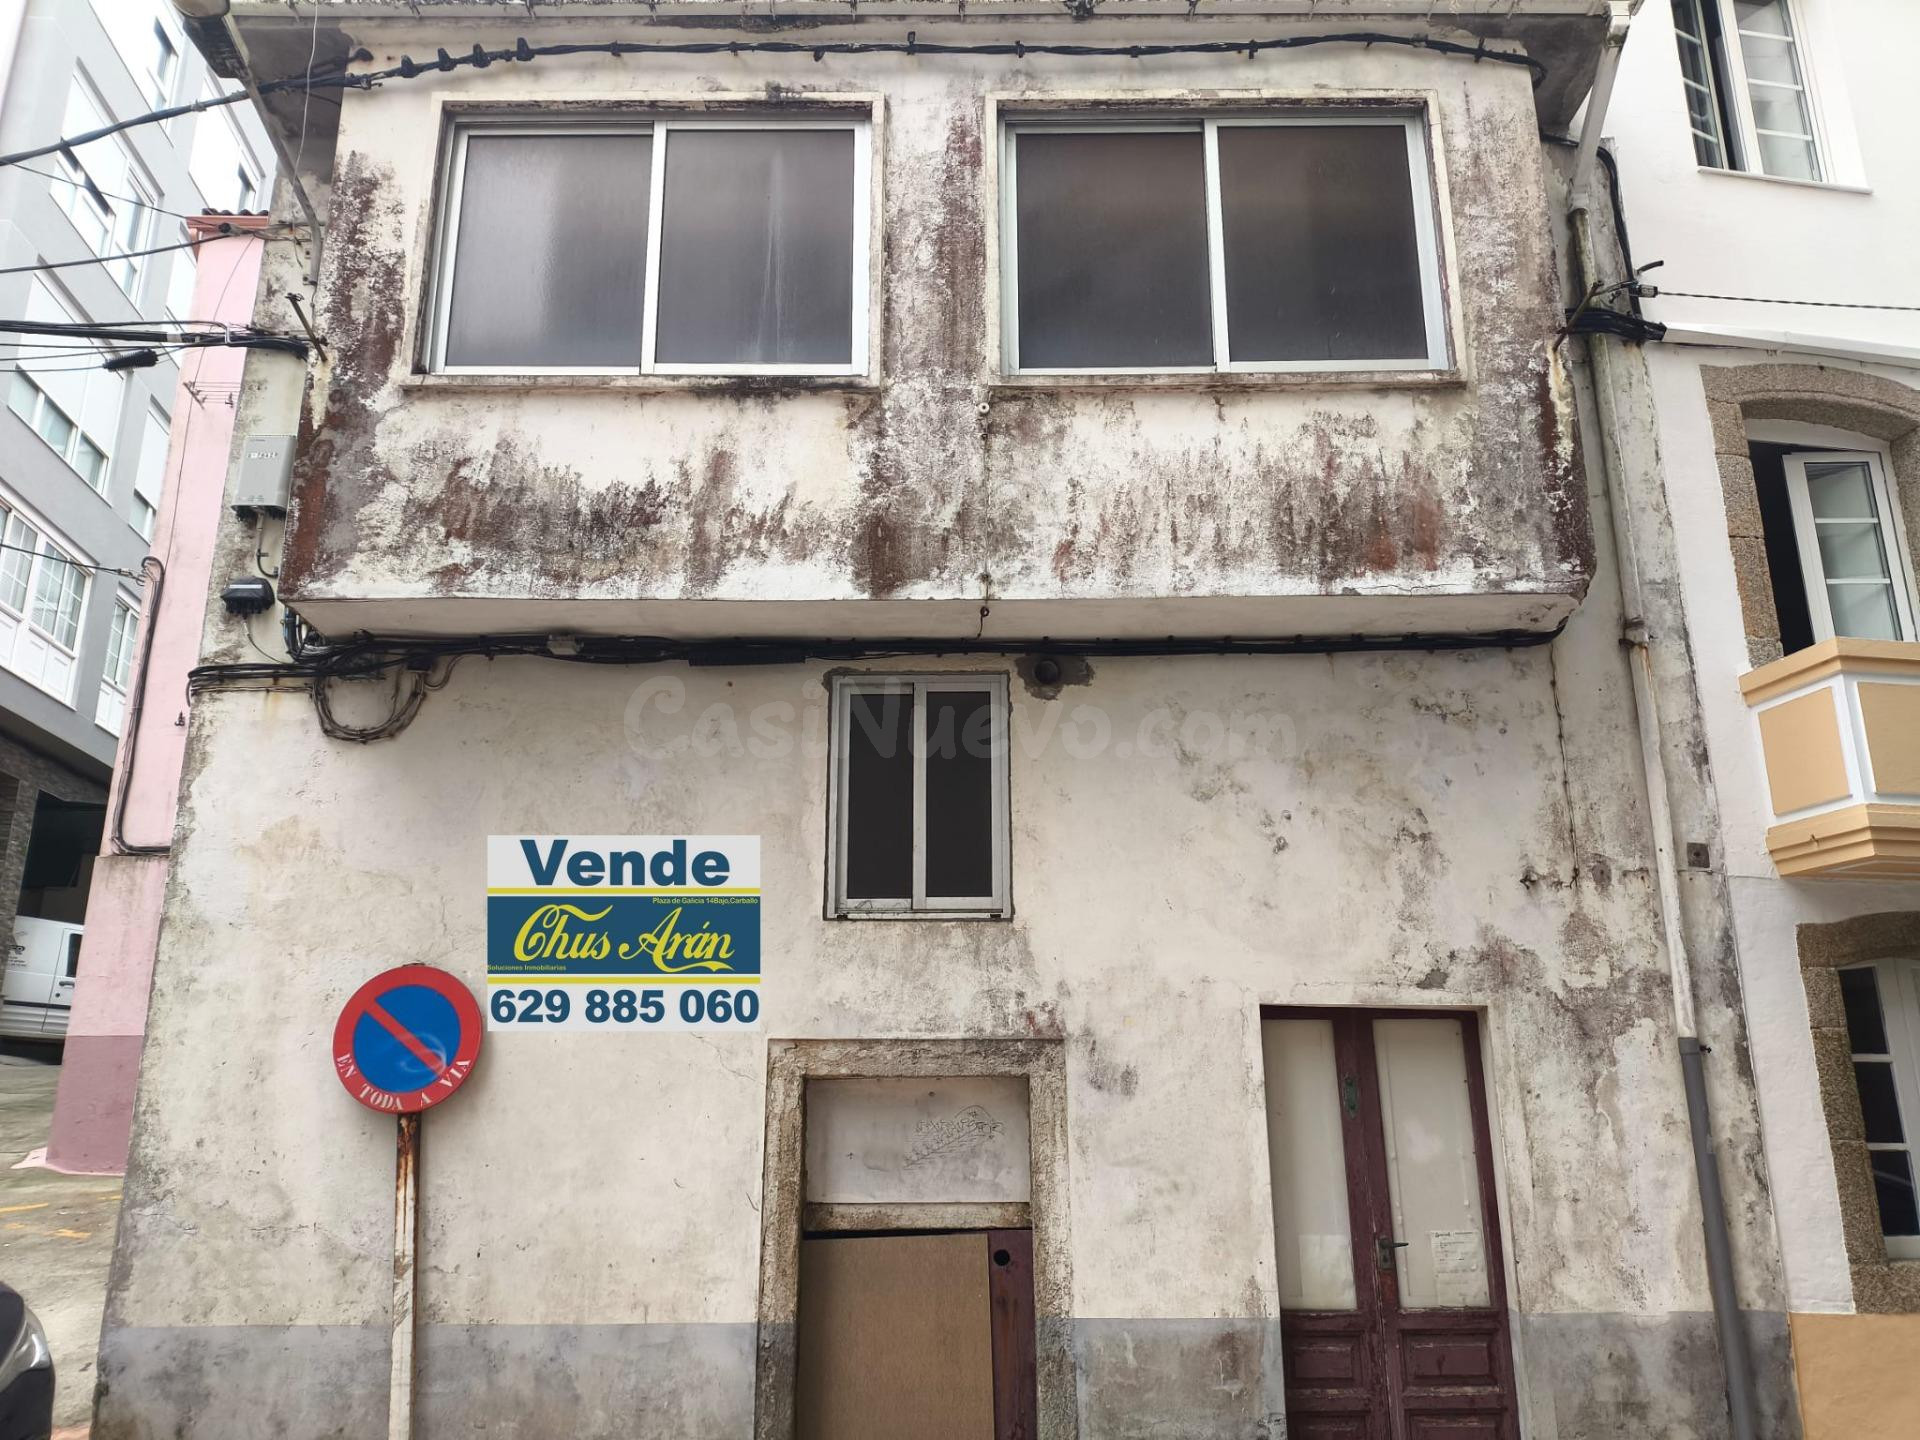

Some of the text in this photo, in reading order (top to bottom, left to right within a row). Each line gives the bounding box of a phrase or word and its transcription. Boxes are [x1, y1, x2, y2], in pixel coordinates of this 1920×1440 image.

[520, 839, 730, 886] Vende
[513, 904, 736, 973] Chus Arán
[490, 989, 759, 1023] 629 885 060
[336, 1053, 357, 1078] EN
[360, 1083, 403, 1110] TODA
[439, 1060, 471, 1087] VIA
